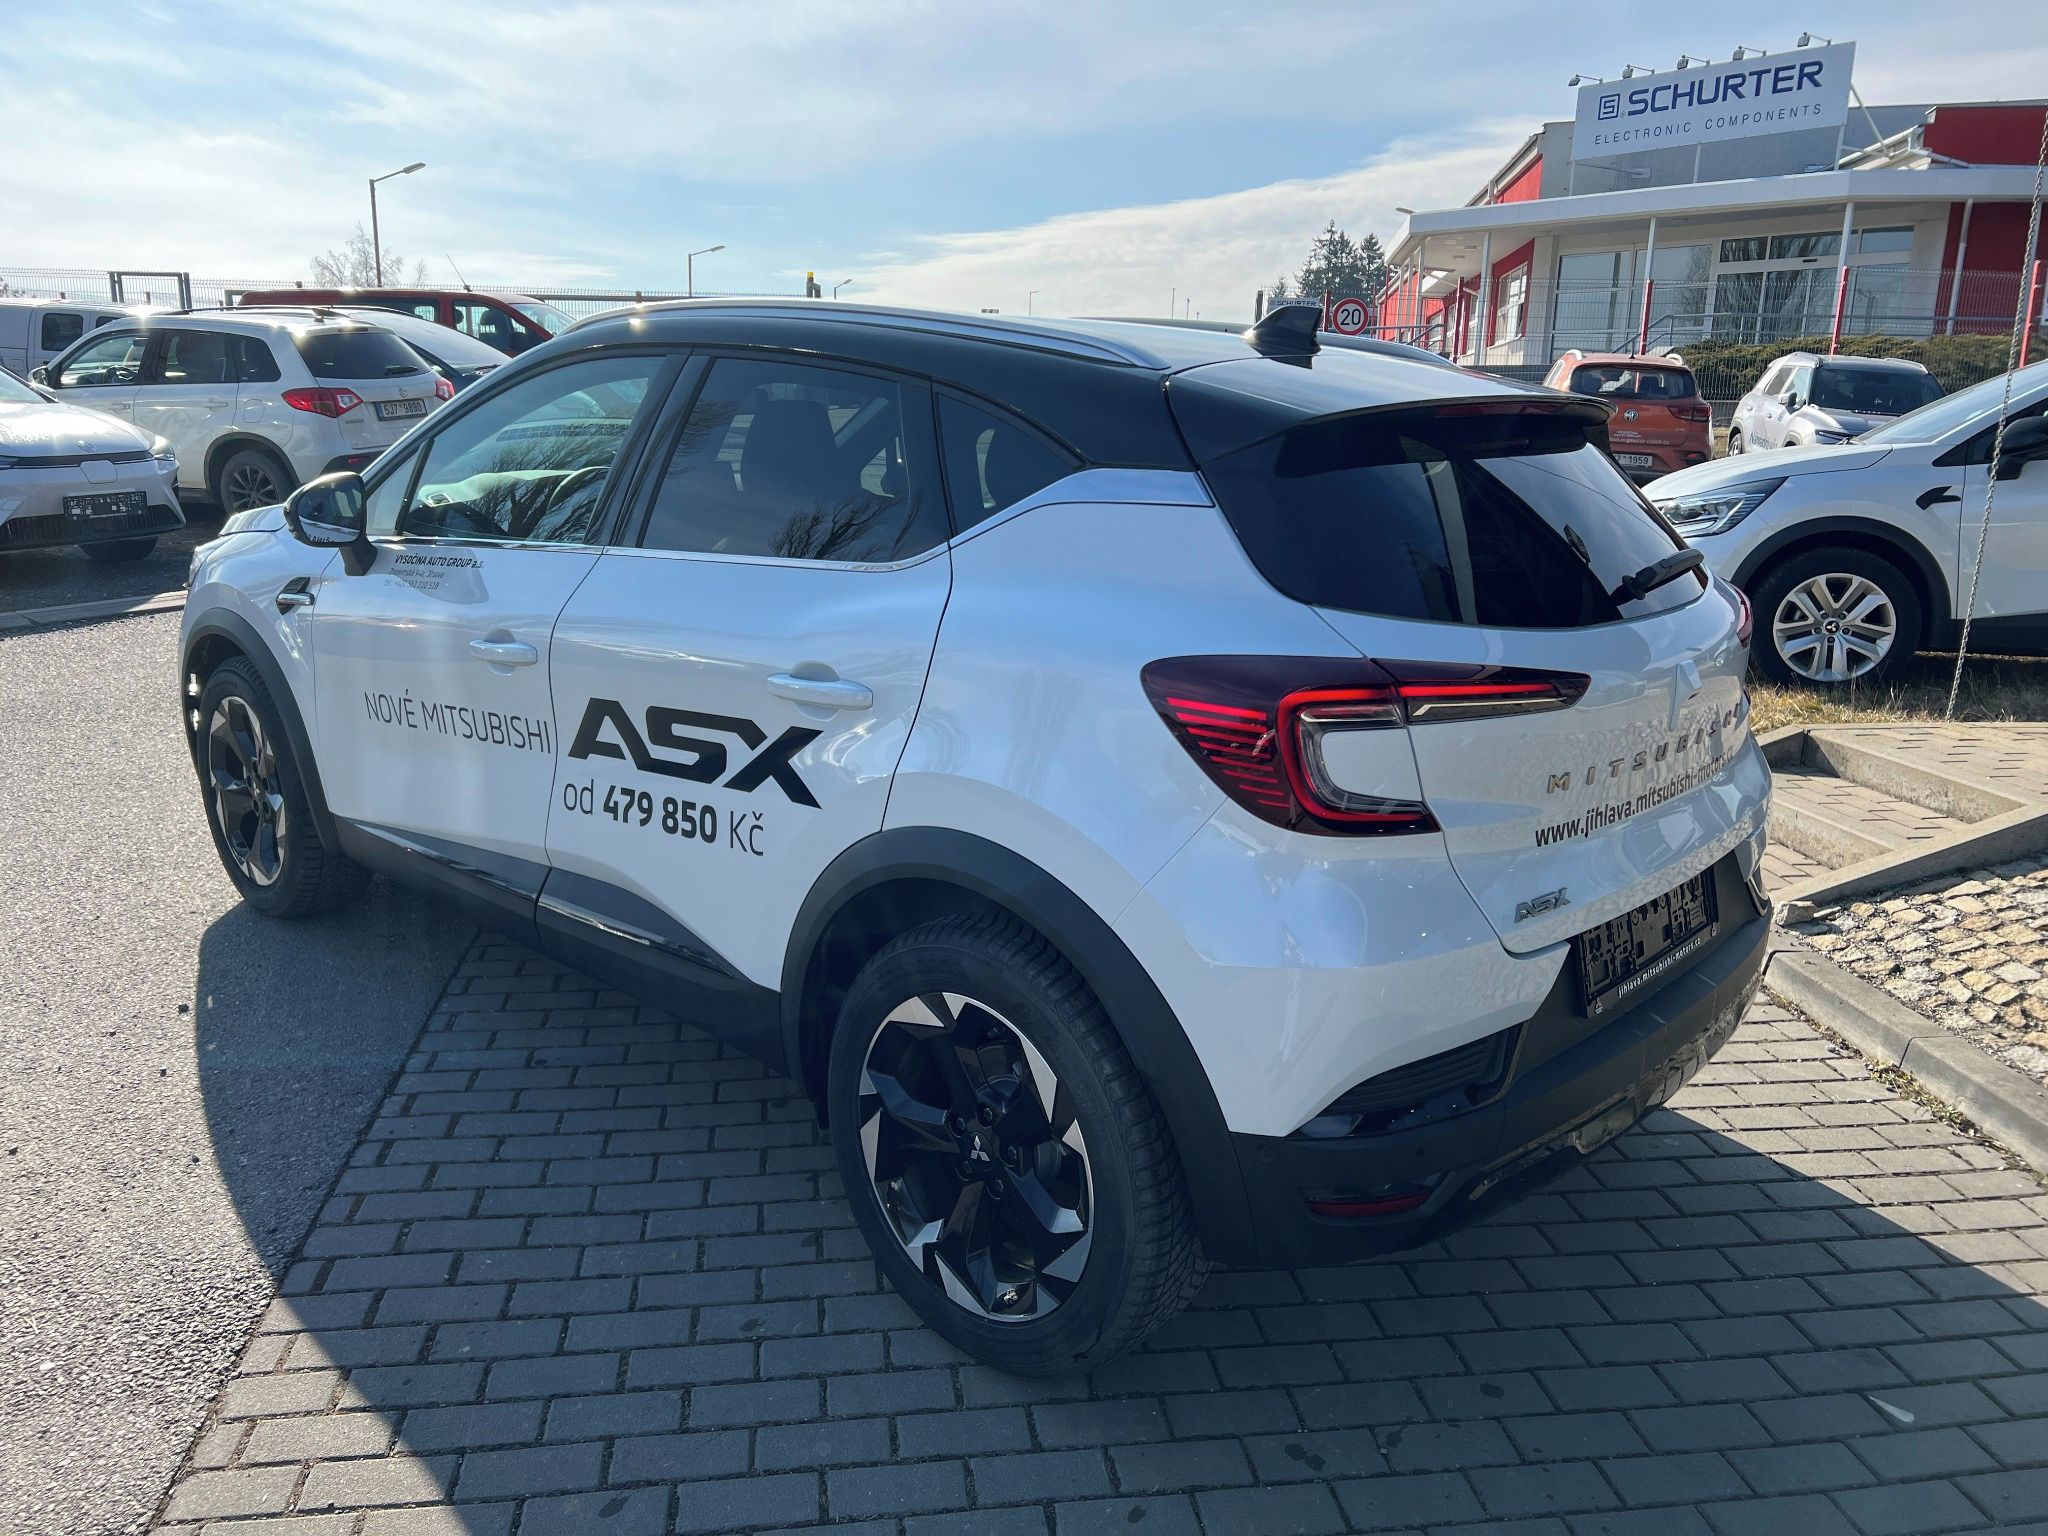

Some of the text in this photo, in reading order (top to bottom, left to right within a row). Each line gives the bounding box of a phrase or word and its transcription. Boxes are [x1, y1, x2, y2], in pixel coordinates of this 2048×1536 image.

[1627, 60, 1823, 117] SCHURTER
[1594, 104, 1822, 145] ELECTRONIC COMPONENTS
[1340, 309, 1361, 325] 20
[1628, 455, 1648, 465] 1959
[394, 553, 427, 565] VYSOČINA
[427, 557, 447, 567] AUTO
[446, 558, 472, 567] GROUP
[364, 688, 551, 754] NOVÉ MITSUBISHI
[1547, 702, 1740, 794] MITSUBISHI
[567, 697, 825, 810] ASX
[563, 779, 764, 856] od 479 850 Kč
[1535, 745, 1734, 848] www.jihlava.mitsubishi-motors.cz
[1514, 887, 1571, 923] ASX
[1618, 937, 1701, 999] jihlava.mitsubishi-motors.cz
